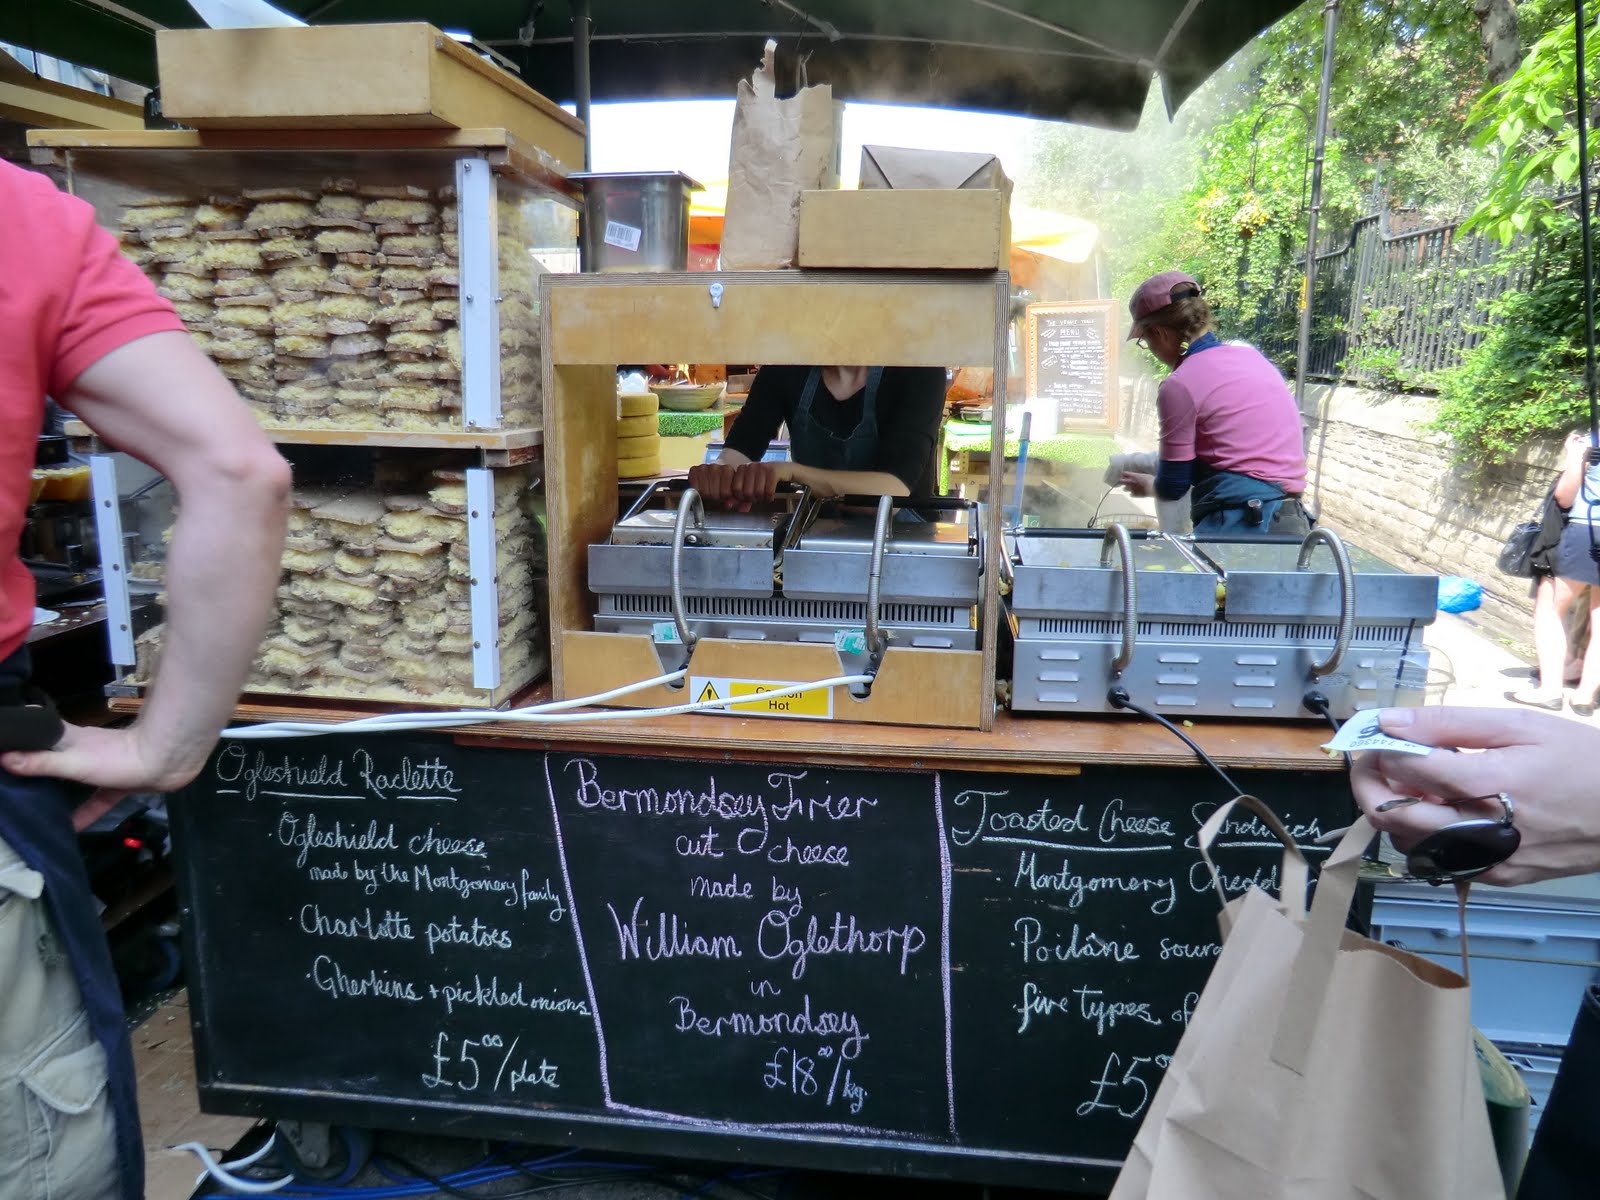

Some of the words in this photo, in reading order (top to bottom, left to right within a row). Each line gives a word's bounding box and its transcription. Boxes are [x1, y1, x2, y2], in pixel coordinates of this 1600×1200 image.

[1060, 328, 1080, 336] MENU
[769, 699, 790, 711] Hot
[216, 744, 349, 800] Ogleshield
[353, 748, 463, 800] Raclette
[564, 759, 769, 854] Bermondsey
[951, 790, 1089, 846] Toasted
[1099, 798, 1176, 843] Cheese
[1183, 801, 1322, 850] Sndwich
[277, 811, 399, 868] Ogleshield
[408, 827, 489, 859] cheese
[675, 825, 724, 858] cut
[767, 836, 850, 867] cheese
[309, 861, 349, 882] made
[354, 859, 381, 896] by
[381, 861, 410, 883] the
[413, 863, 519, 907] Montgomery
[521, 868, 568, 923] family
[690, 873, 754, 900] made
[771, 876, 804, 915] by
[1013, 850, 1177, 915] Montgomery
[1188, 860, 1319, 893] Chedd
[300, 903, 416, 941] Charlotte
[424, 915, 513, 955] potatoes
[607, 896, 742, 961] William
[757, 910, 926, 980] Oglethorp
[313, 954, 424, 1000] Gherkins
[530, 988, 592, 1016] onions
[750, 970, 781, 997] in
[1016, 981, 1069, 1035] five
[1072, 983, 1163, 1036] types
[669, 994, 870, 1060] Bermondsey
